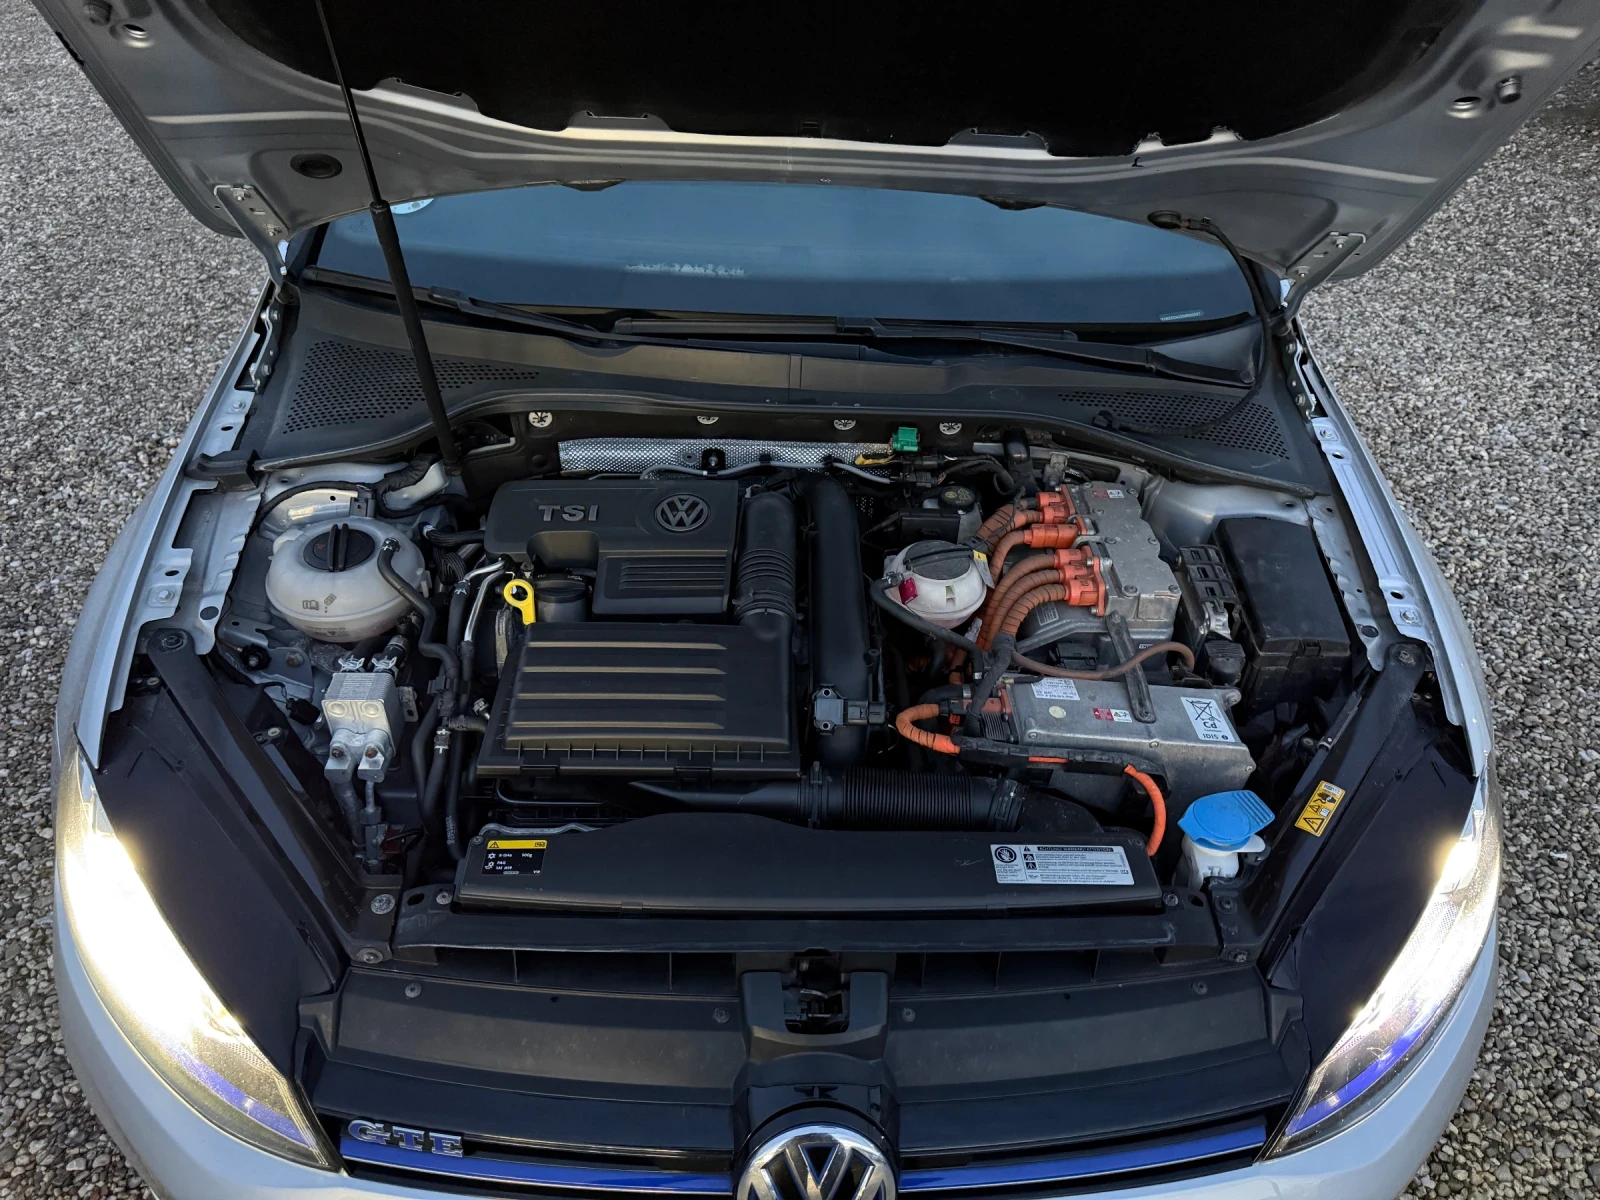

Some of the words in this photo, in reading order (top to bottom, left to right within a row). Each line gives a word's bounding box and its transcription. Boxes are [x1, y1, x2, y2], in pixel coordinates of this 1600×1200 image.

[538, 504, 599, 522] TSI
[656, 494, 711, 532] VW
[348, 1120, 463, 1158] GTE
